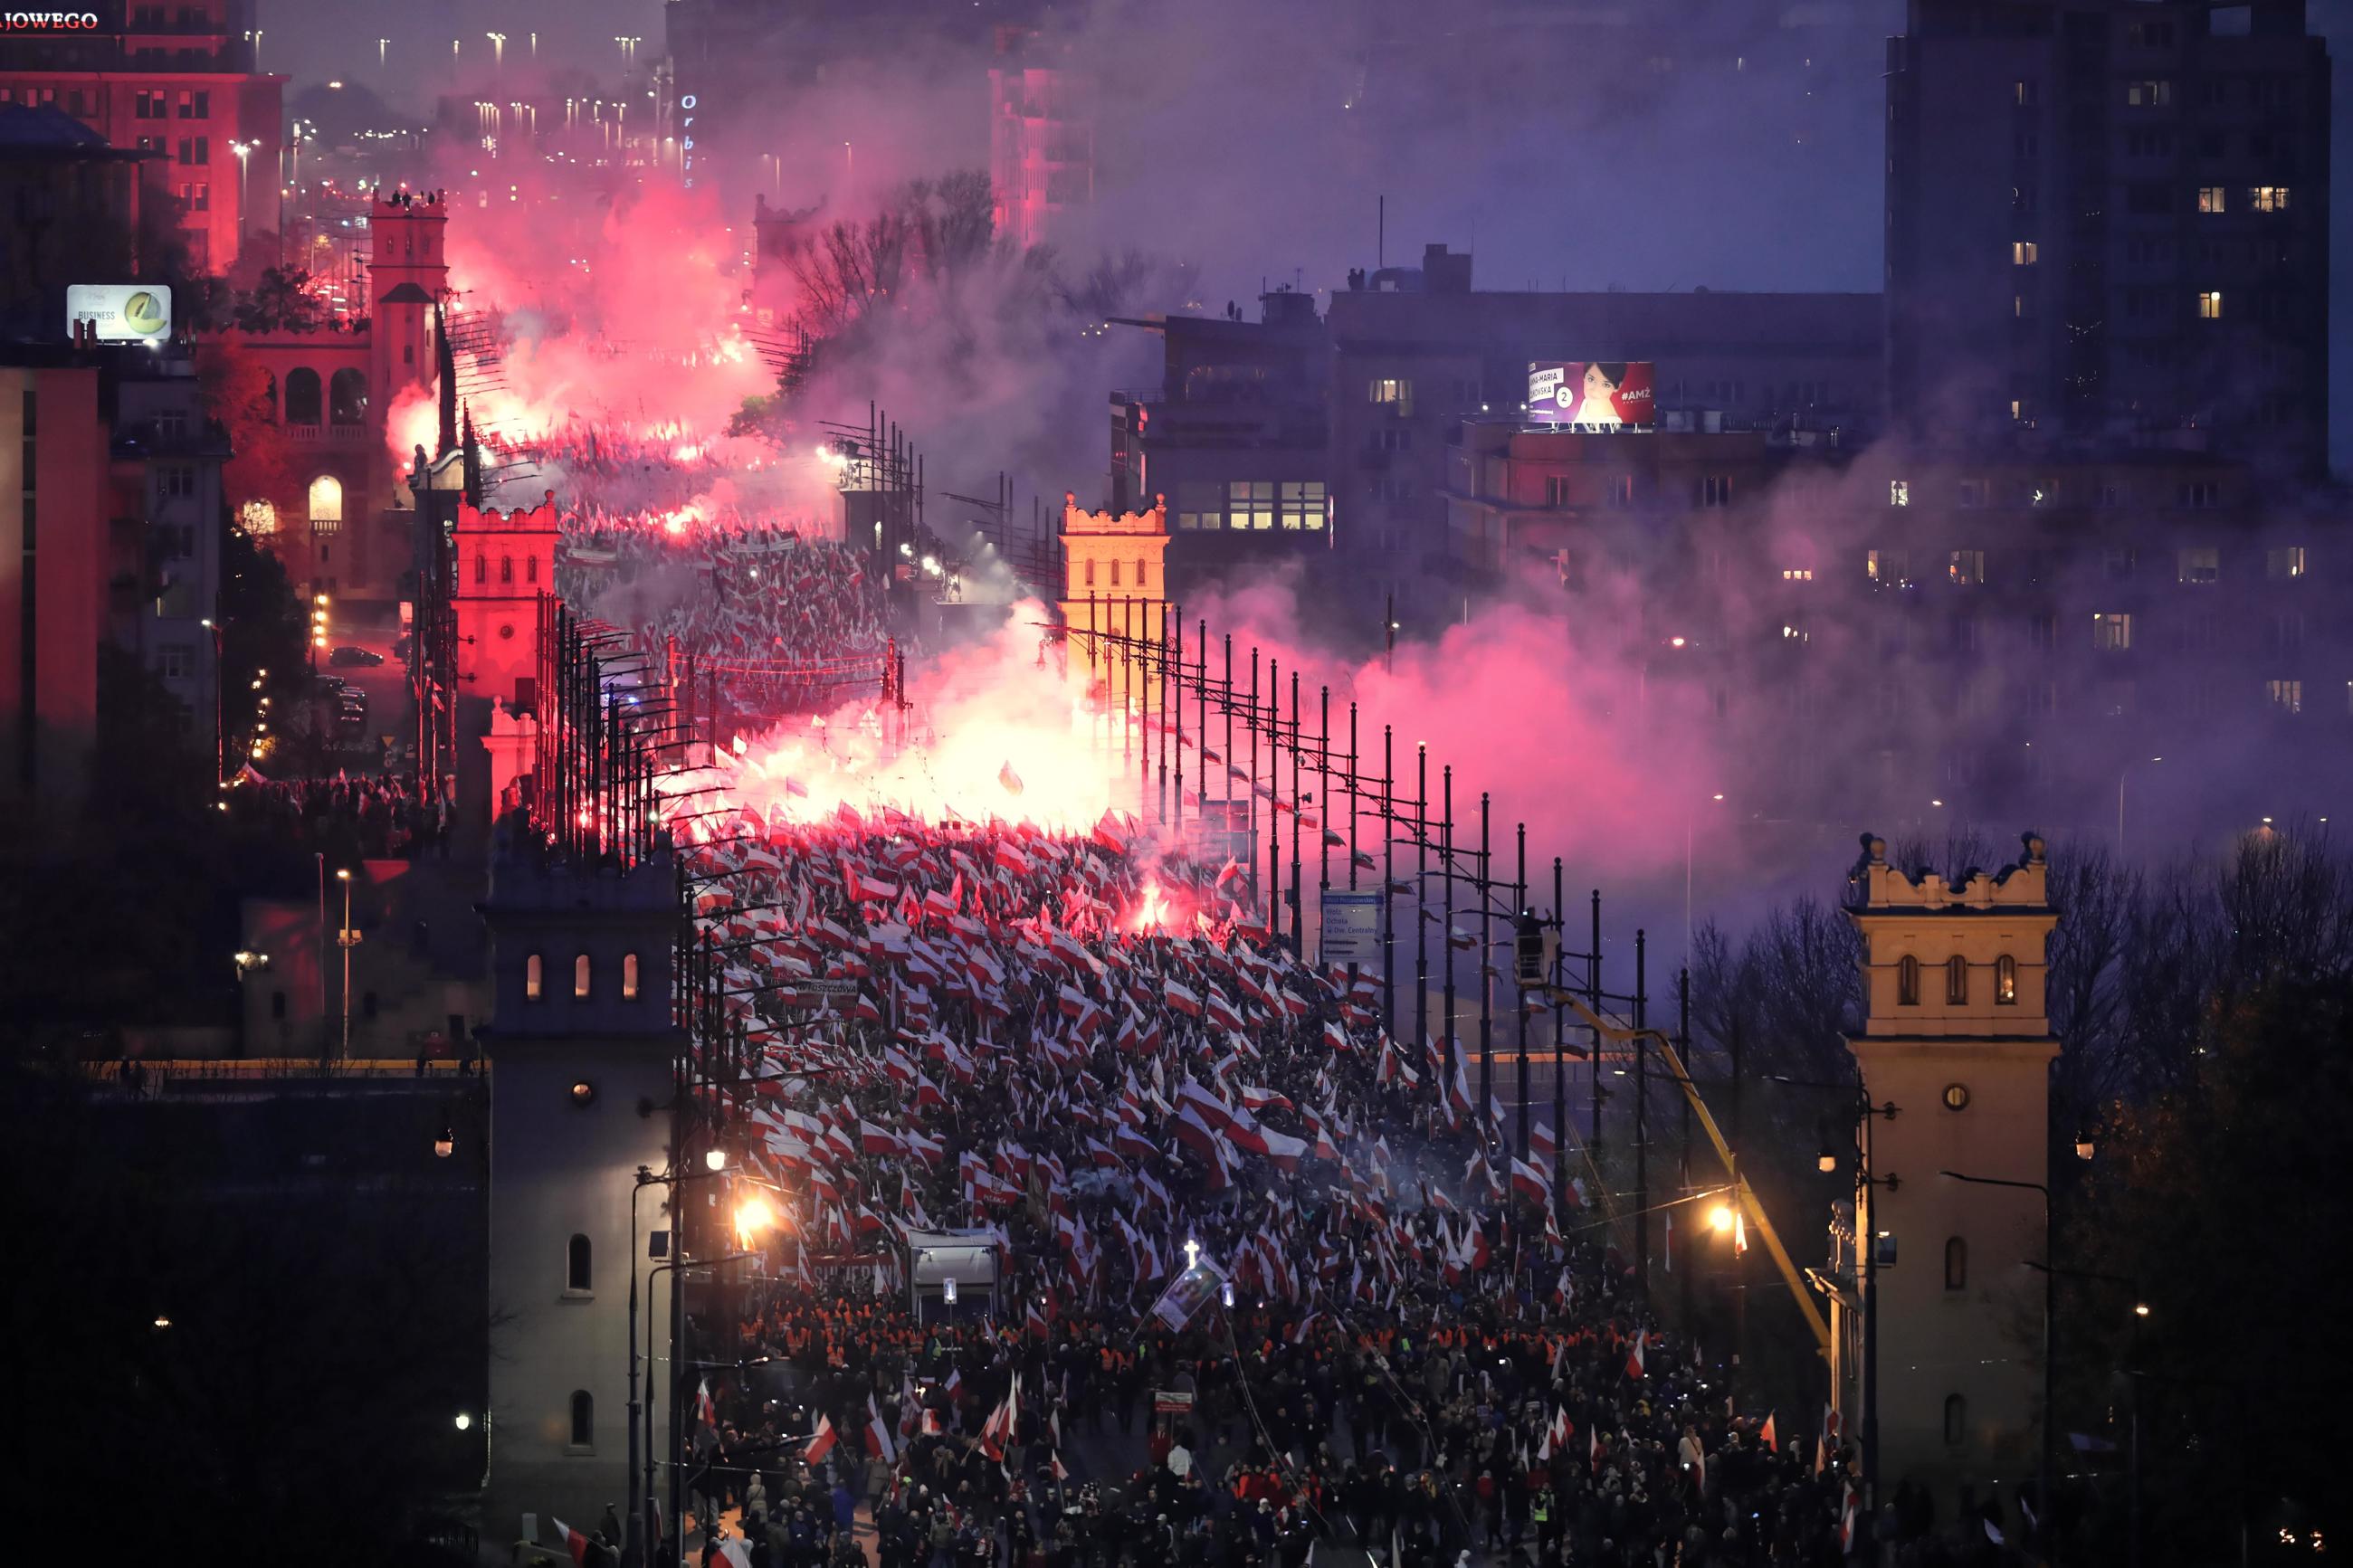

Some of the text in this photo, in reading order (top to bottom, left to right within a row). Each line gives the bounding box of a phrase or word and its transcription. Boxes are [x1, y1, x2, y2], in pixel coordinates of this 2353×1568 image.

[0, 12, 98, 30] JOWEGO
[681, 95, 697, 188] Orbis
[78, 310, 115, 320] BUSINESS
[1561, 392, 1567, 401] 2
[1621, 386, 1651, 401] #AMŻ
[1348, 927, 1377, 935] Centralny
